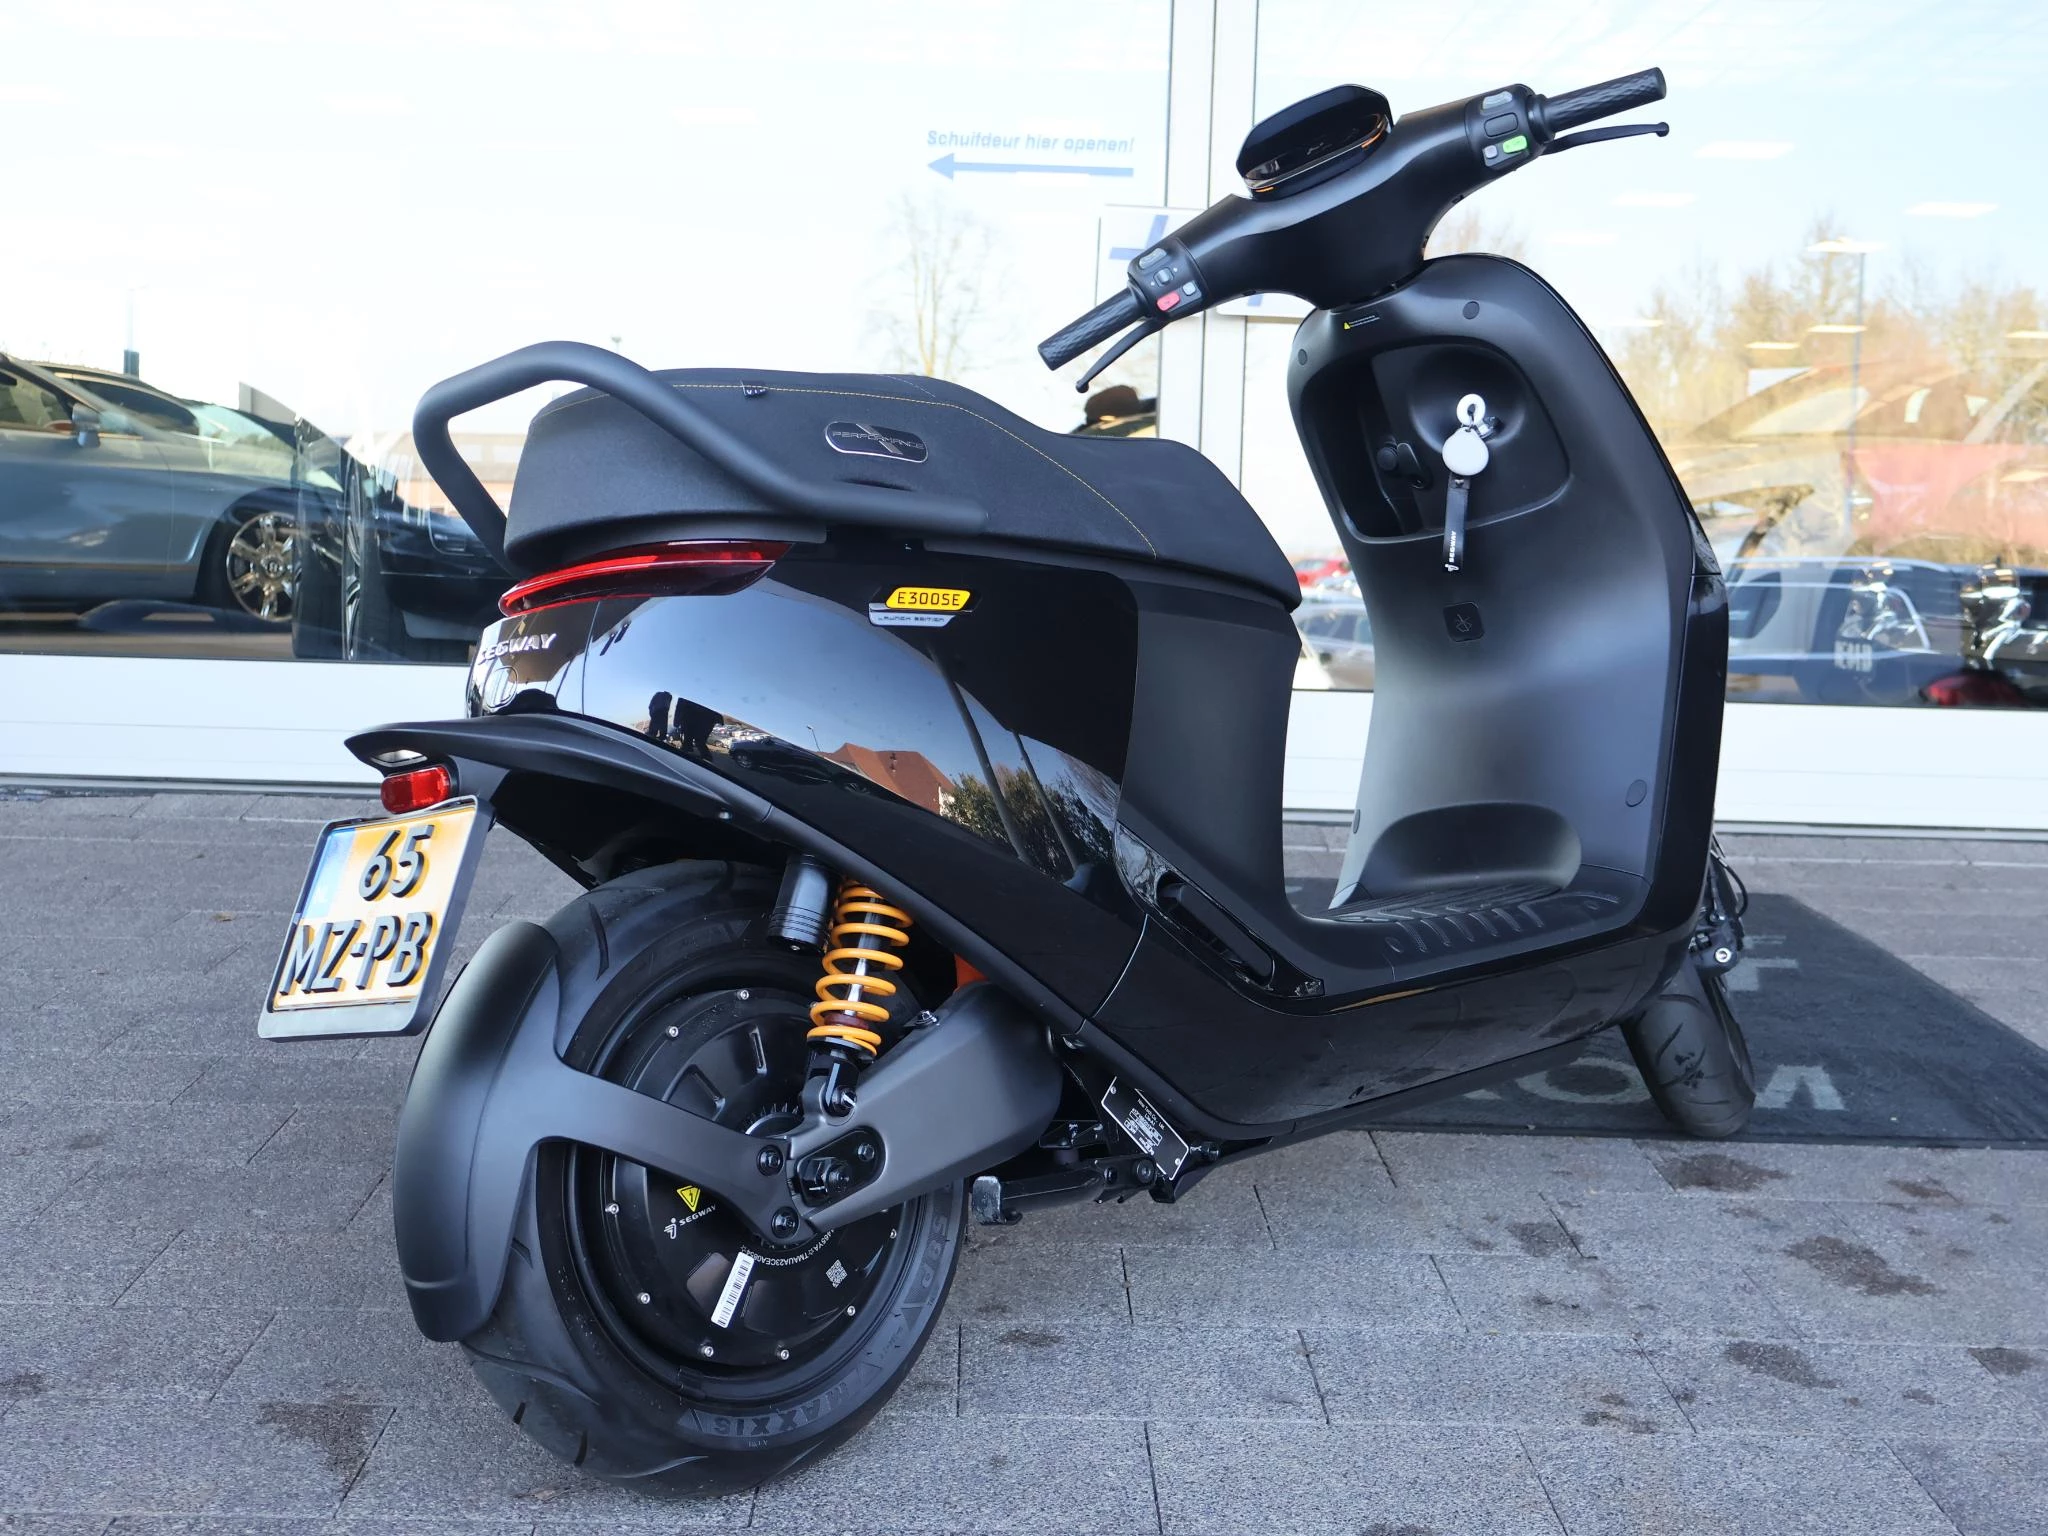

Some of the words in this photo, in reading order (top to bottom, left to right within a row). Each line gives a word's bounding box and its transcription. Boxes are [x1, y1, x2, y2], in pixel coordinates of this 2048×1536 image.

[927, 130, 1021, 150] Schuifdeur
[1025, 134, 1060, 150] hier
[1063, 137, 1135, 154] openen!
[832, 430, 925, 450] PERFORMANCE
[897, 591, 961, 607] E300SE
[478, 632, 557, 665] SEGWAY
[358, 824, 435, 901] 65
[279, 911, 433, 996] MZ-PB
[679, 1203, 717, 1227] SEGWAY
[713, 1381, 849, 1436] MAXXIS
